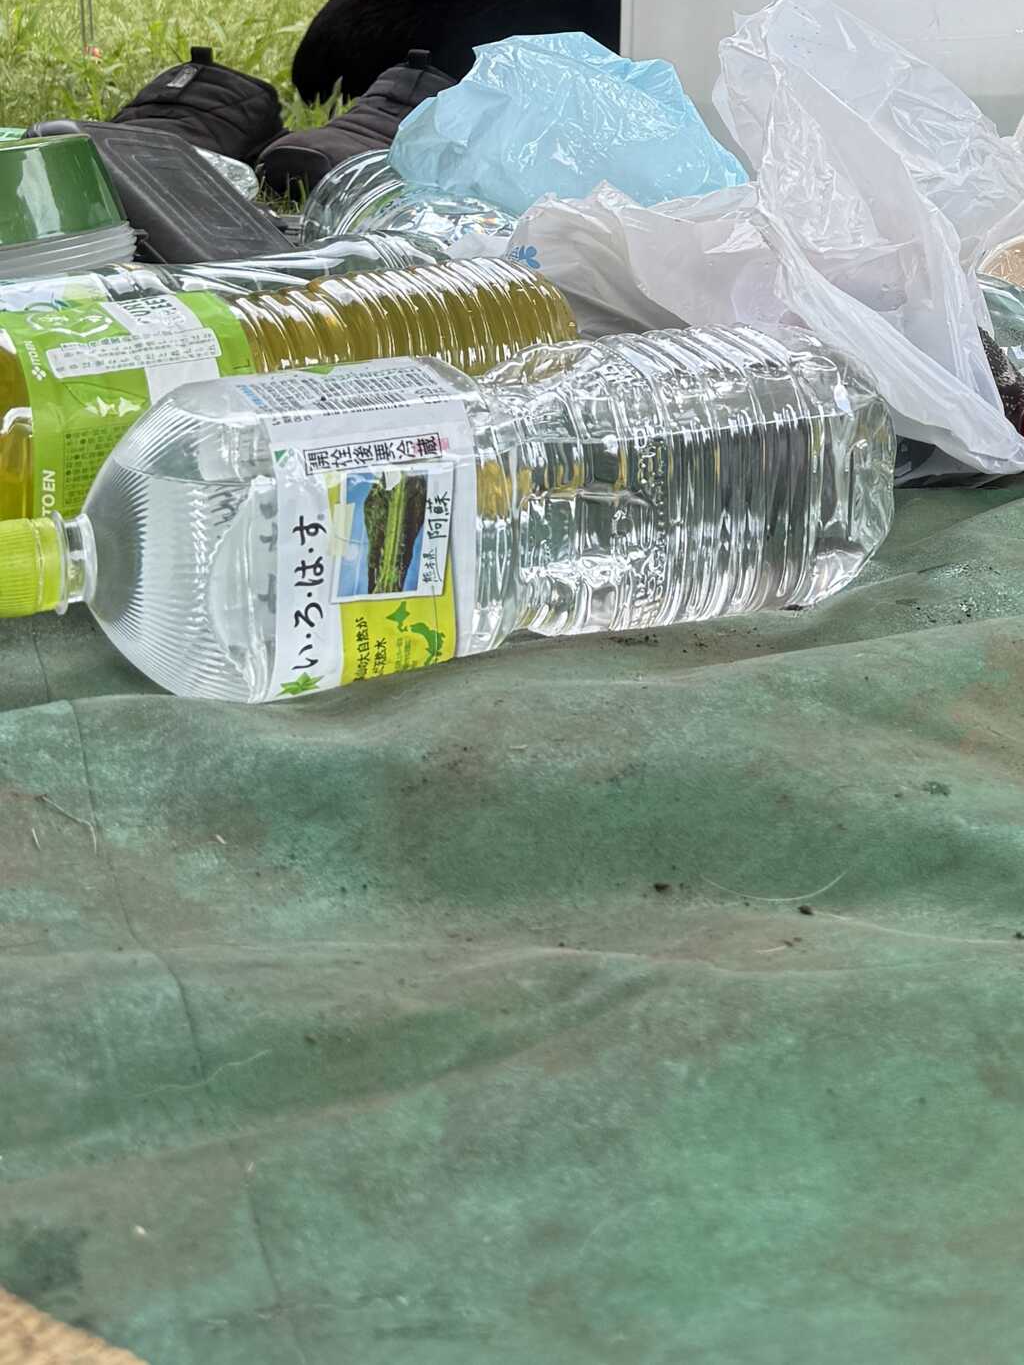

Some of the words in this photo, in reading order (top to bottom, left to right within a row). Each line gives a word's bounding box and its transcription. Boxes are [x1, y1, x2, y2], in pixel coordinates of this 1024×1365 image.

[308, 435, 439, 471] 開栓後要冷蔵
[42, 469, 56, 492] EN
[42, 494, 56, 517] TO
[426, 491, 452, 540] 阿蘇
